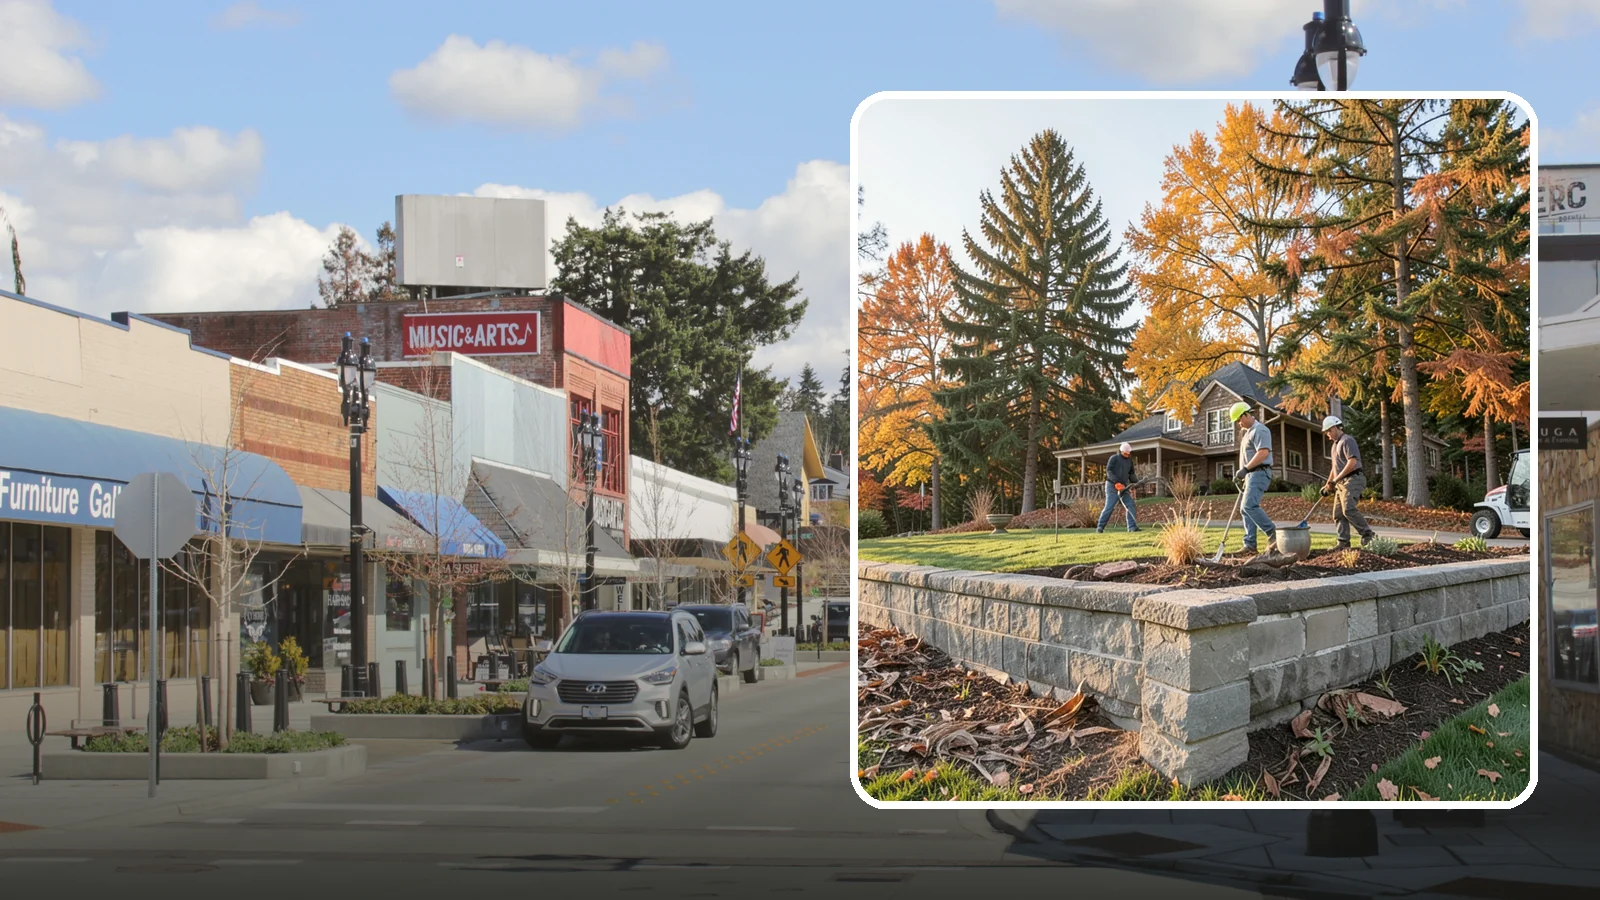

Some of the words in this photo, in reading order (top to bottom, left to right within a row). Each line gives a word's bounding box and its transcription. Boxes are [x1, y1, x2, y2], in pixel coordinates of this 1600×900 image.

[1540, 427, 1577, 436] UGA
[0, 471, 79, 516] Furniture
[89, 482, 122, 520] Gal
